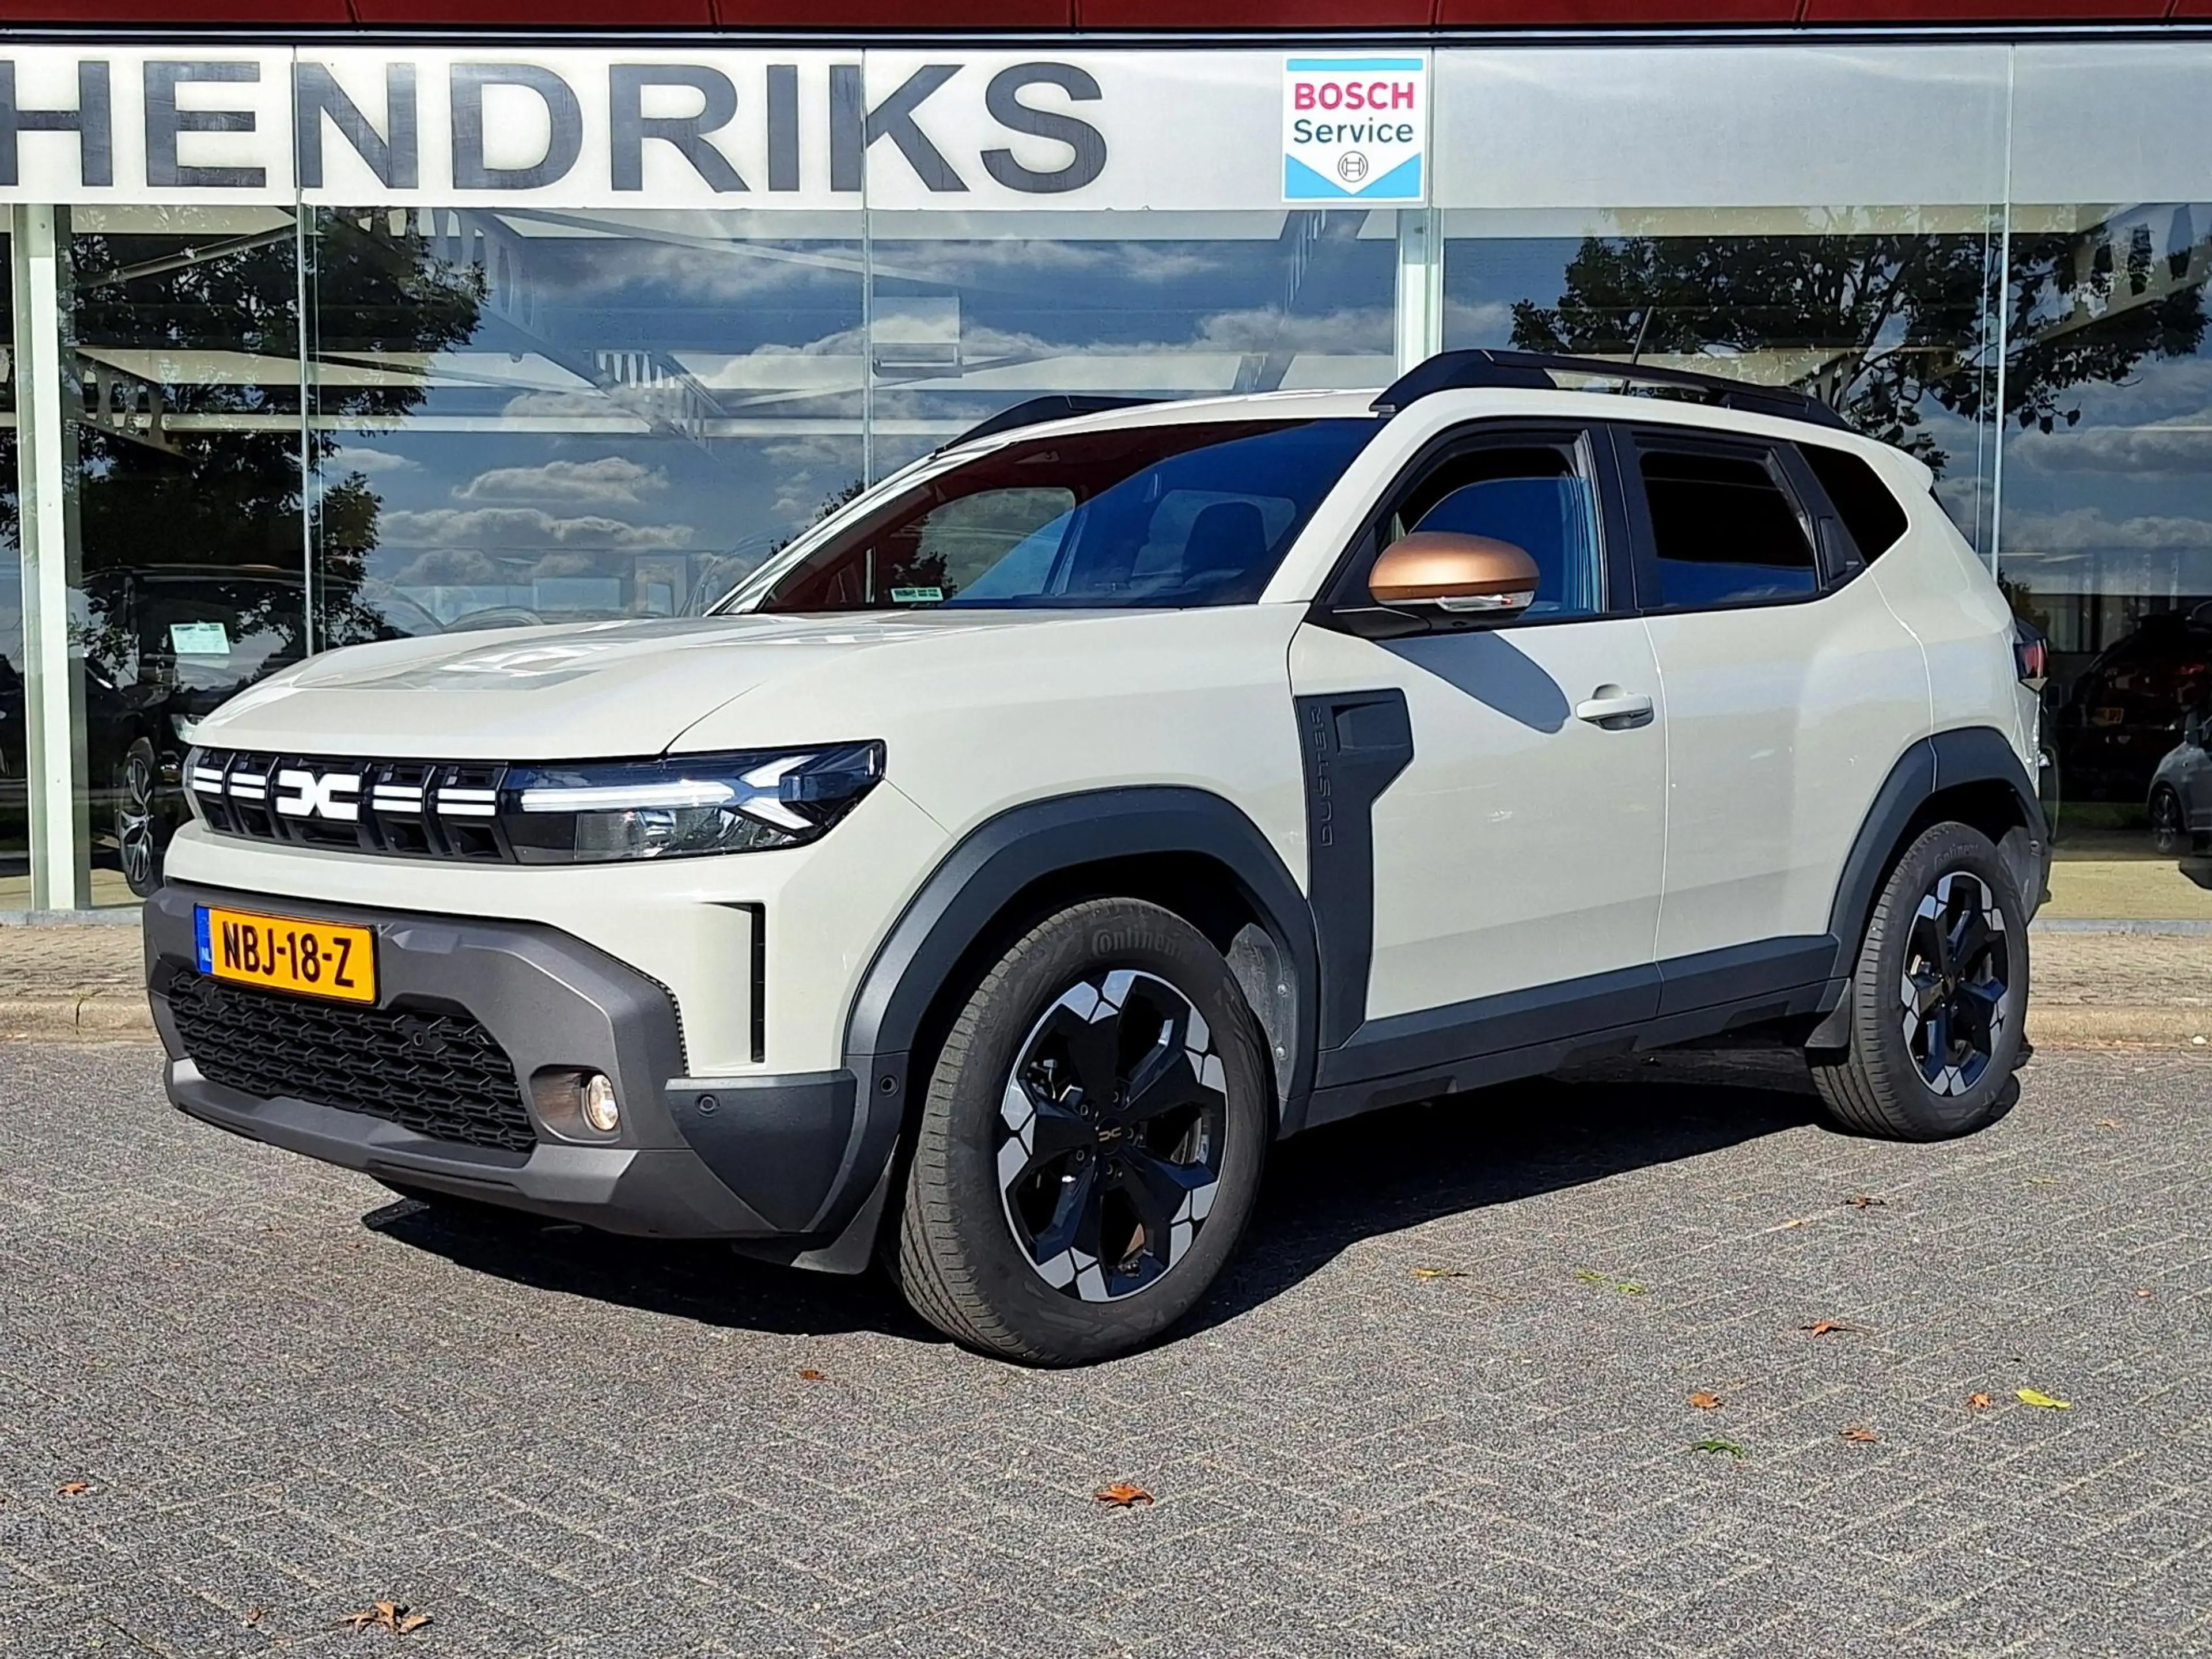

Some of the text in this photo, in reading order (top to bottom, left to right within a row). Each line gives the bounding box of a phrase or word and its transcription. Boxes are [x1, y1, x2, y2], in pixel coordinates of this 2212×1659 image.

[0, 60, 1107, 194] HENDRIKS
[1294, 82, 1414, 110] BOSCH
[1293, 117, 1414, 144] Service
[1310, 706, 1333, 847] DUSTER
[222, 921, 355, 988] NBJ-18-Z
